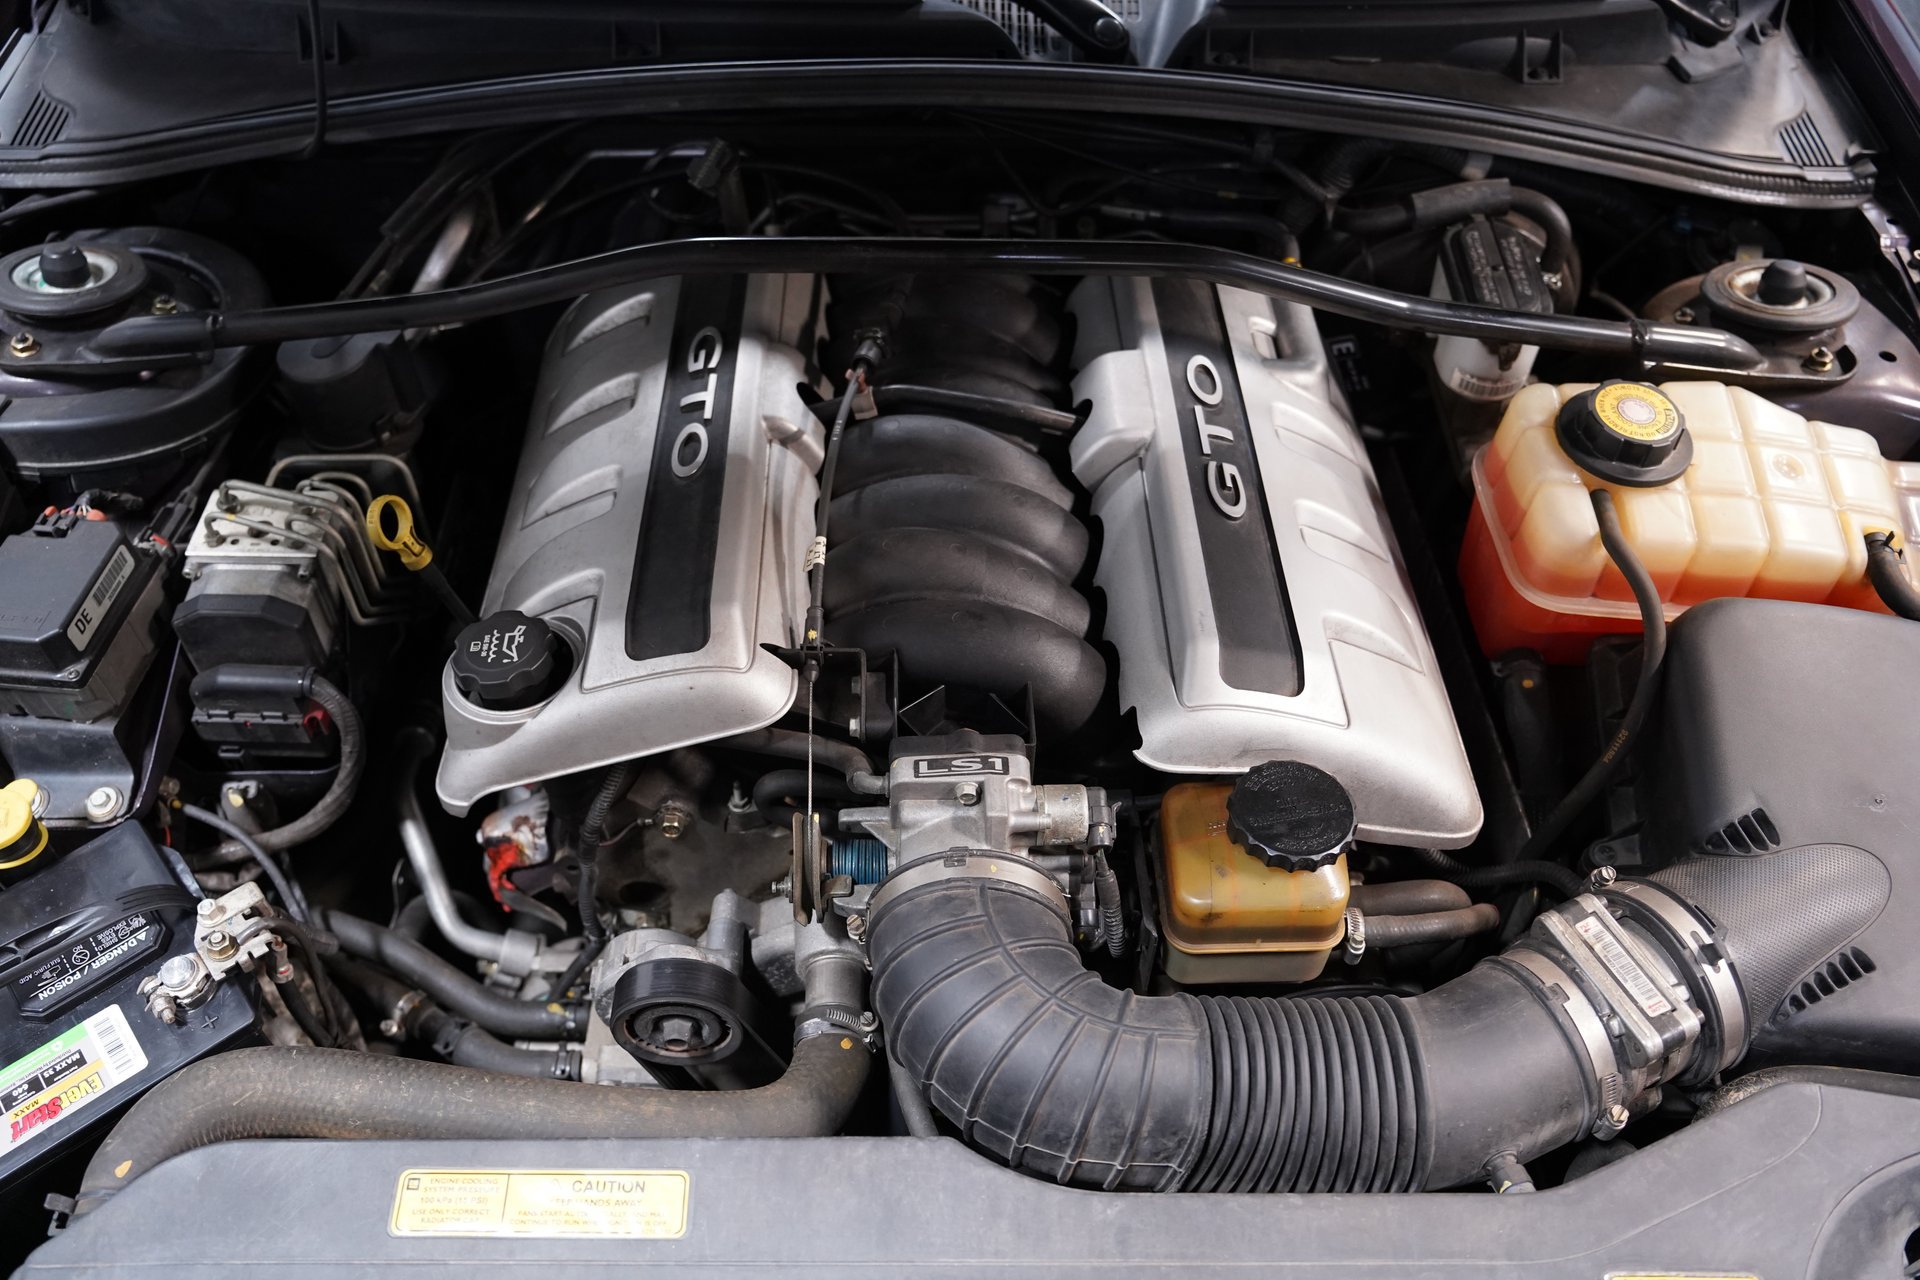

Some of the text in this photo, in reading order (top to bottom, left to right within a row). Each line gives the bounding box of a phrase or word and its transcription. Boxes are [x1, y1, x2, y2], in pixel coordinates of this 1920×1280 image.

[671, 326, 723, 478] GTO
[1187, 354, 1247, 518] GTO
[74, 608, 94, 635] DE
[918, 758, 1003, 774] LS1
[96, 920, 127, 941] EXPLOSIVE
[72, 944, 83, 954] NO
[90, 937, 138, 970] DANGER
[97, 936, 119, 952] SHIELD
[17, 957, 61, 984] SULFURIC ACID
[37, 970, 82, 1001] POISON
[54, 1052, 81, 1072] MAXX
[42, 1068, 55, 1078] 35
[11, 1083, 29, 1097] 640
[10, 1072, 105, 1143] EverStart
[13, 1098, 39, 1120] MAXX
[572, 1180, 646, 1194] CAUTION
